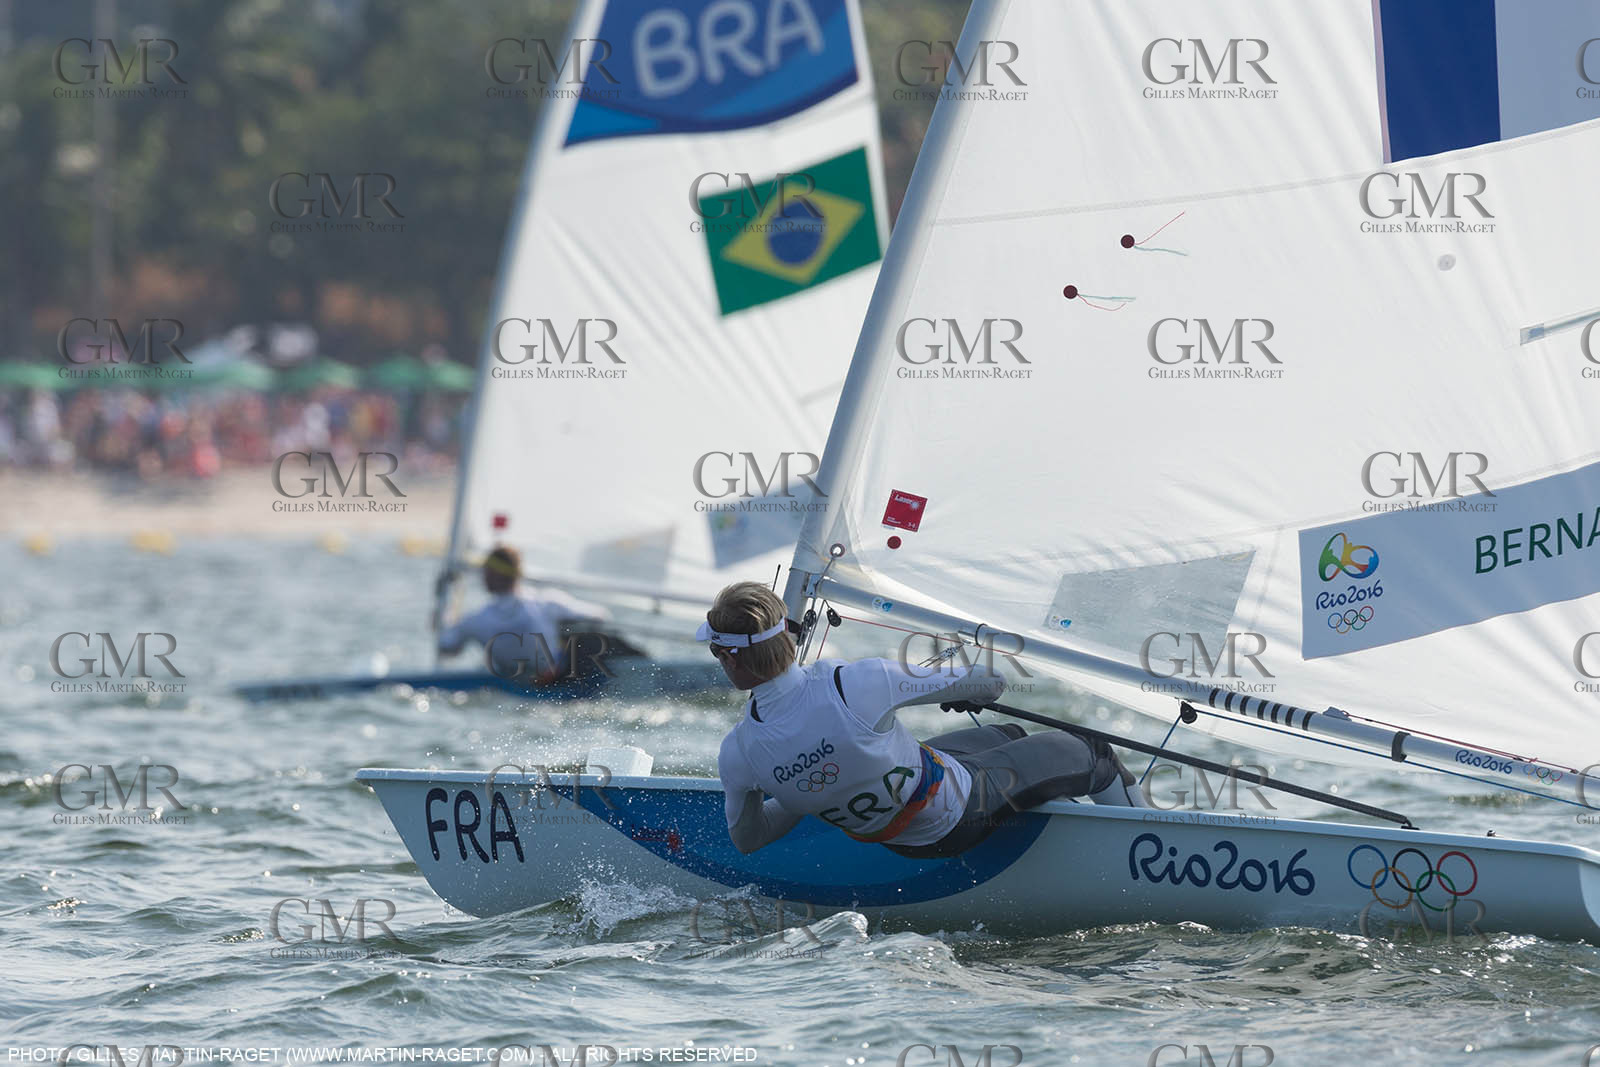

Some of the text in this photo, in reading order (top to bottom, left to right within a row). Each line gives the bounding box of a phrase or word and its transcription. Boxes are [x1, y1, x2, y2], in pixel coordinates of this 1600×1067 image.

[632, 0, 823, 97] BRA
[1316, 580, 1384, 610] Rio2016
[773, 738, 834, 784] Rio2016
[1455, 749, 1513, 775] Rio2016
[425, 788, 524, 864] FRA
[819, 766, 915, 829] FRA
[1129, 833, 1315, 895] Rio2016
